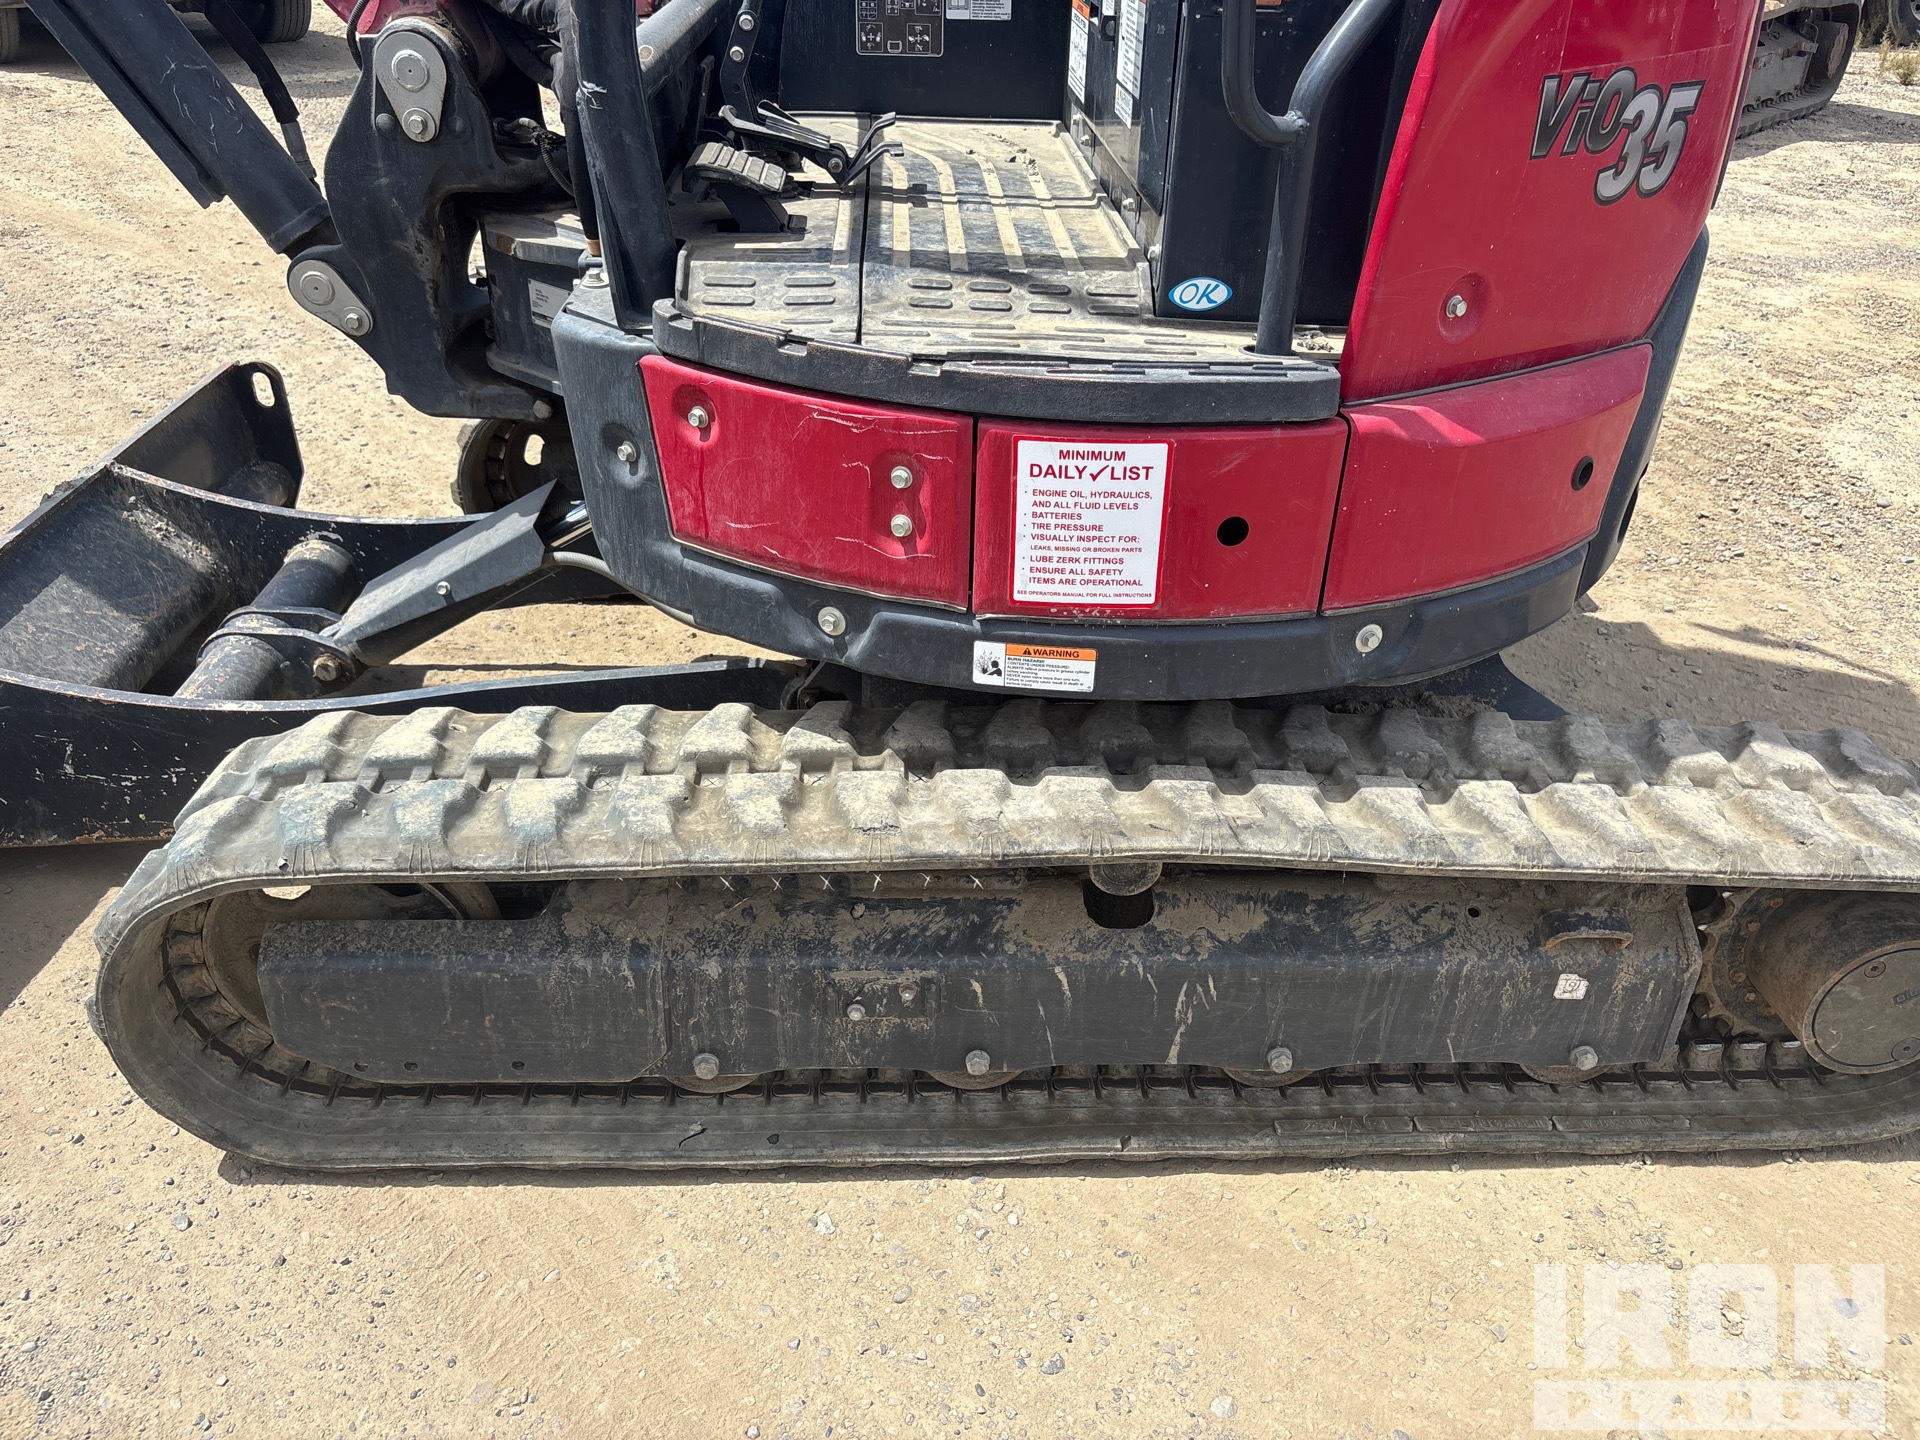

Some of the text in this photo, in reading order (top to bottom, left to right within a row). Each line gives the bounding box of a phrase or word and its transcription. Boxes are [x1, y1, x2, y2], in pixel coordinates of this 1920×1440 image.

[1179, 283, 1220, 304] OK
[1059, 450, 1126, 461] MINIMUM
[1030, 464, 1154, 480] DAILY LIST
[1032, 489, 1152, 500] ENGINE OIL, HYDRAULICS,
[1032, 512, 1082, 520] BATTERIES
[1054, 524, 1104, 532] PRESSURE
[1031, 533, 1074, 542] VISUALLY
[1030, 567, 1066, 575] ENSURE
[1029, 577, 1056, 585] ITEMS
[1033, 648, 1079, 658] WARNING
